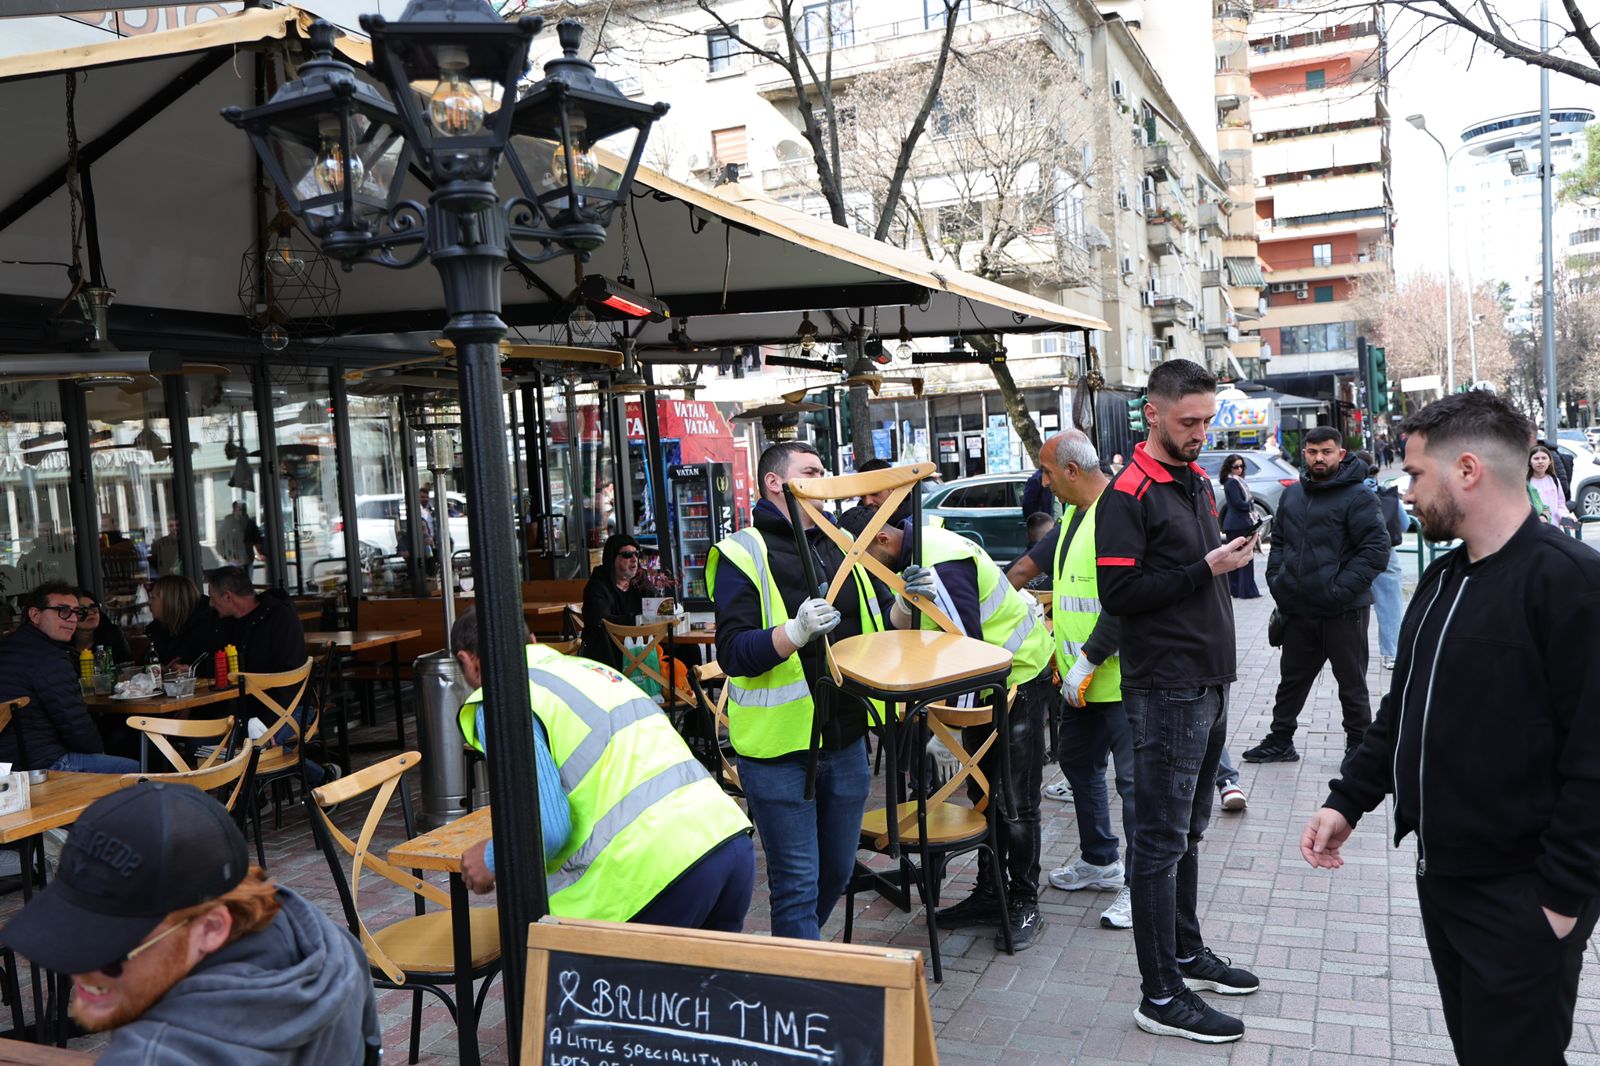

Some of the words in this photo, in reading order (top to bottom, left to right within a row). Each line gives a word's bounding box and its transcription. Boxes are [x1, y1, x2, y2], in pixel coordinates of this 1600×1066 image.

[673, 401, 709, 420] VATAN,
[684, 418, 719, 434] VATAN.
[676, 468, 700, 477] VATAN
[591, 978, 710, 1031] BRUNCH
[729, 999, 835, 1055] TIME
[549, 1027, 562, 1045] A
[567, 1032, 615, 1053] LITTLE
[623, 1043, 722, 1066] SPECIALITY
[550, 1053, 590, 1066] LOTS
